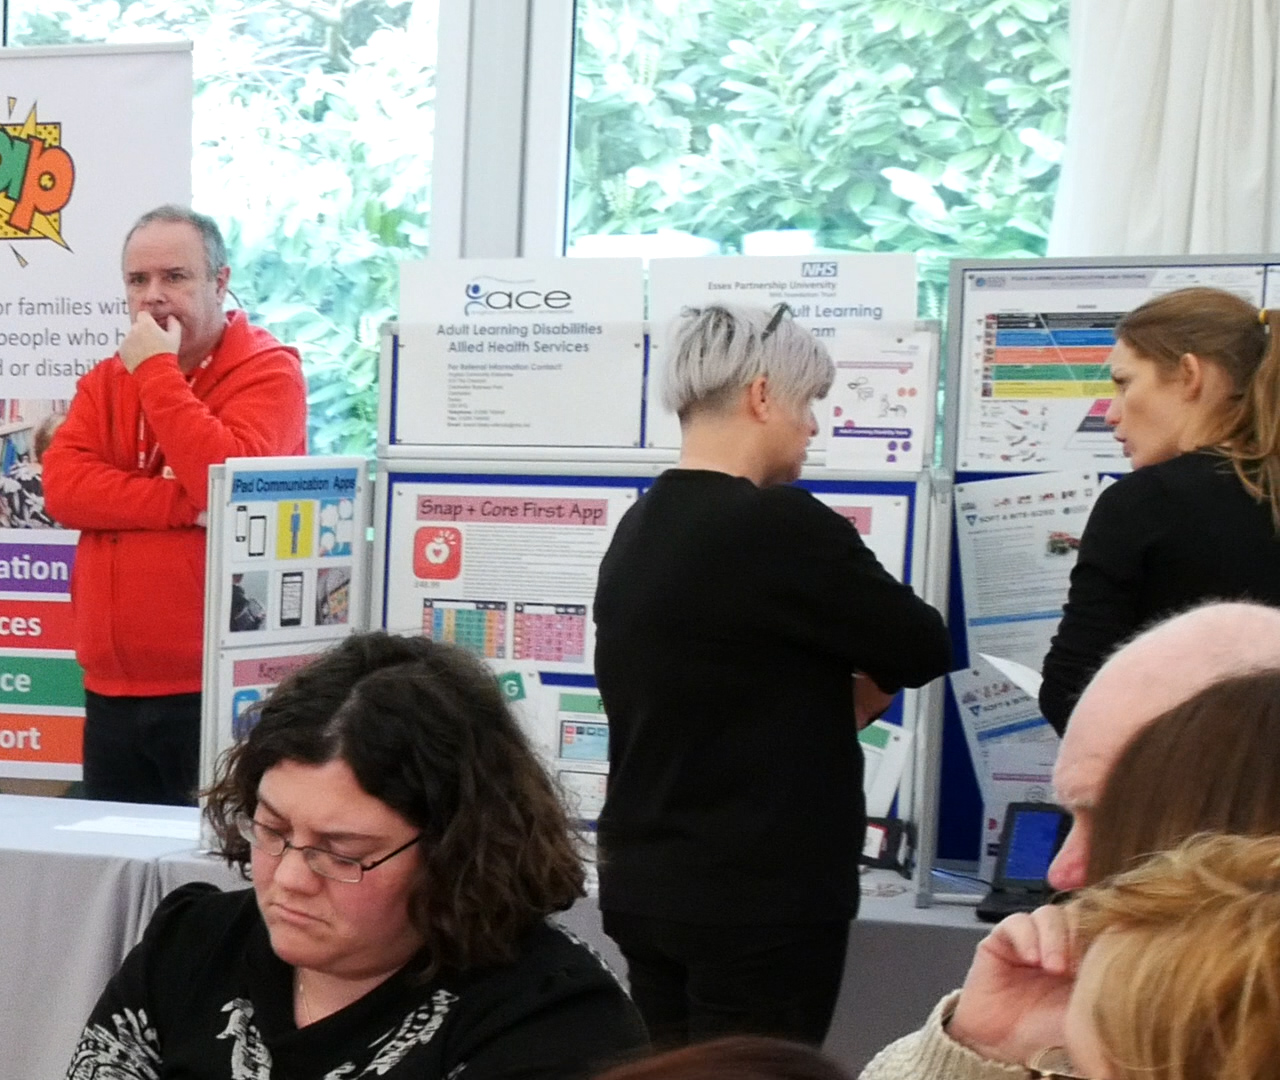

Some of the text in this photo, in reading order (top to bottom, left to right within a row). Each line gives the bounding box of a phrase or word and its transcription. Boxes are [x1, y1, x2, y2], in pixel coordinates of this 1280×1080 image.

[803, 263, 837, 276] NHS
[708, 281, 837, 291] Essex Partnership University
[18, 298, 92, 316] families
[485, 290, 572, 310] ace
[815, 304, 883, 320] Learning
[67, 328, 109, 346] who
[437, 323, 603, 338] Adult Learning Disabilities
[449, 341, 590, 353] Allied Health Services
[10, 363, 29, 377] or
[233, 475, 357, 494] iPad Communication Apps
[420, 500, 463, 521] Snap
[481, 501, 518, 517] Core
[523, 502, 565, 518] First
[570, 503, 603, 525] App
